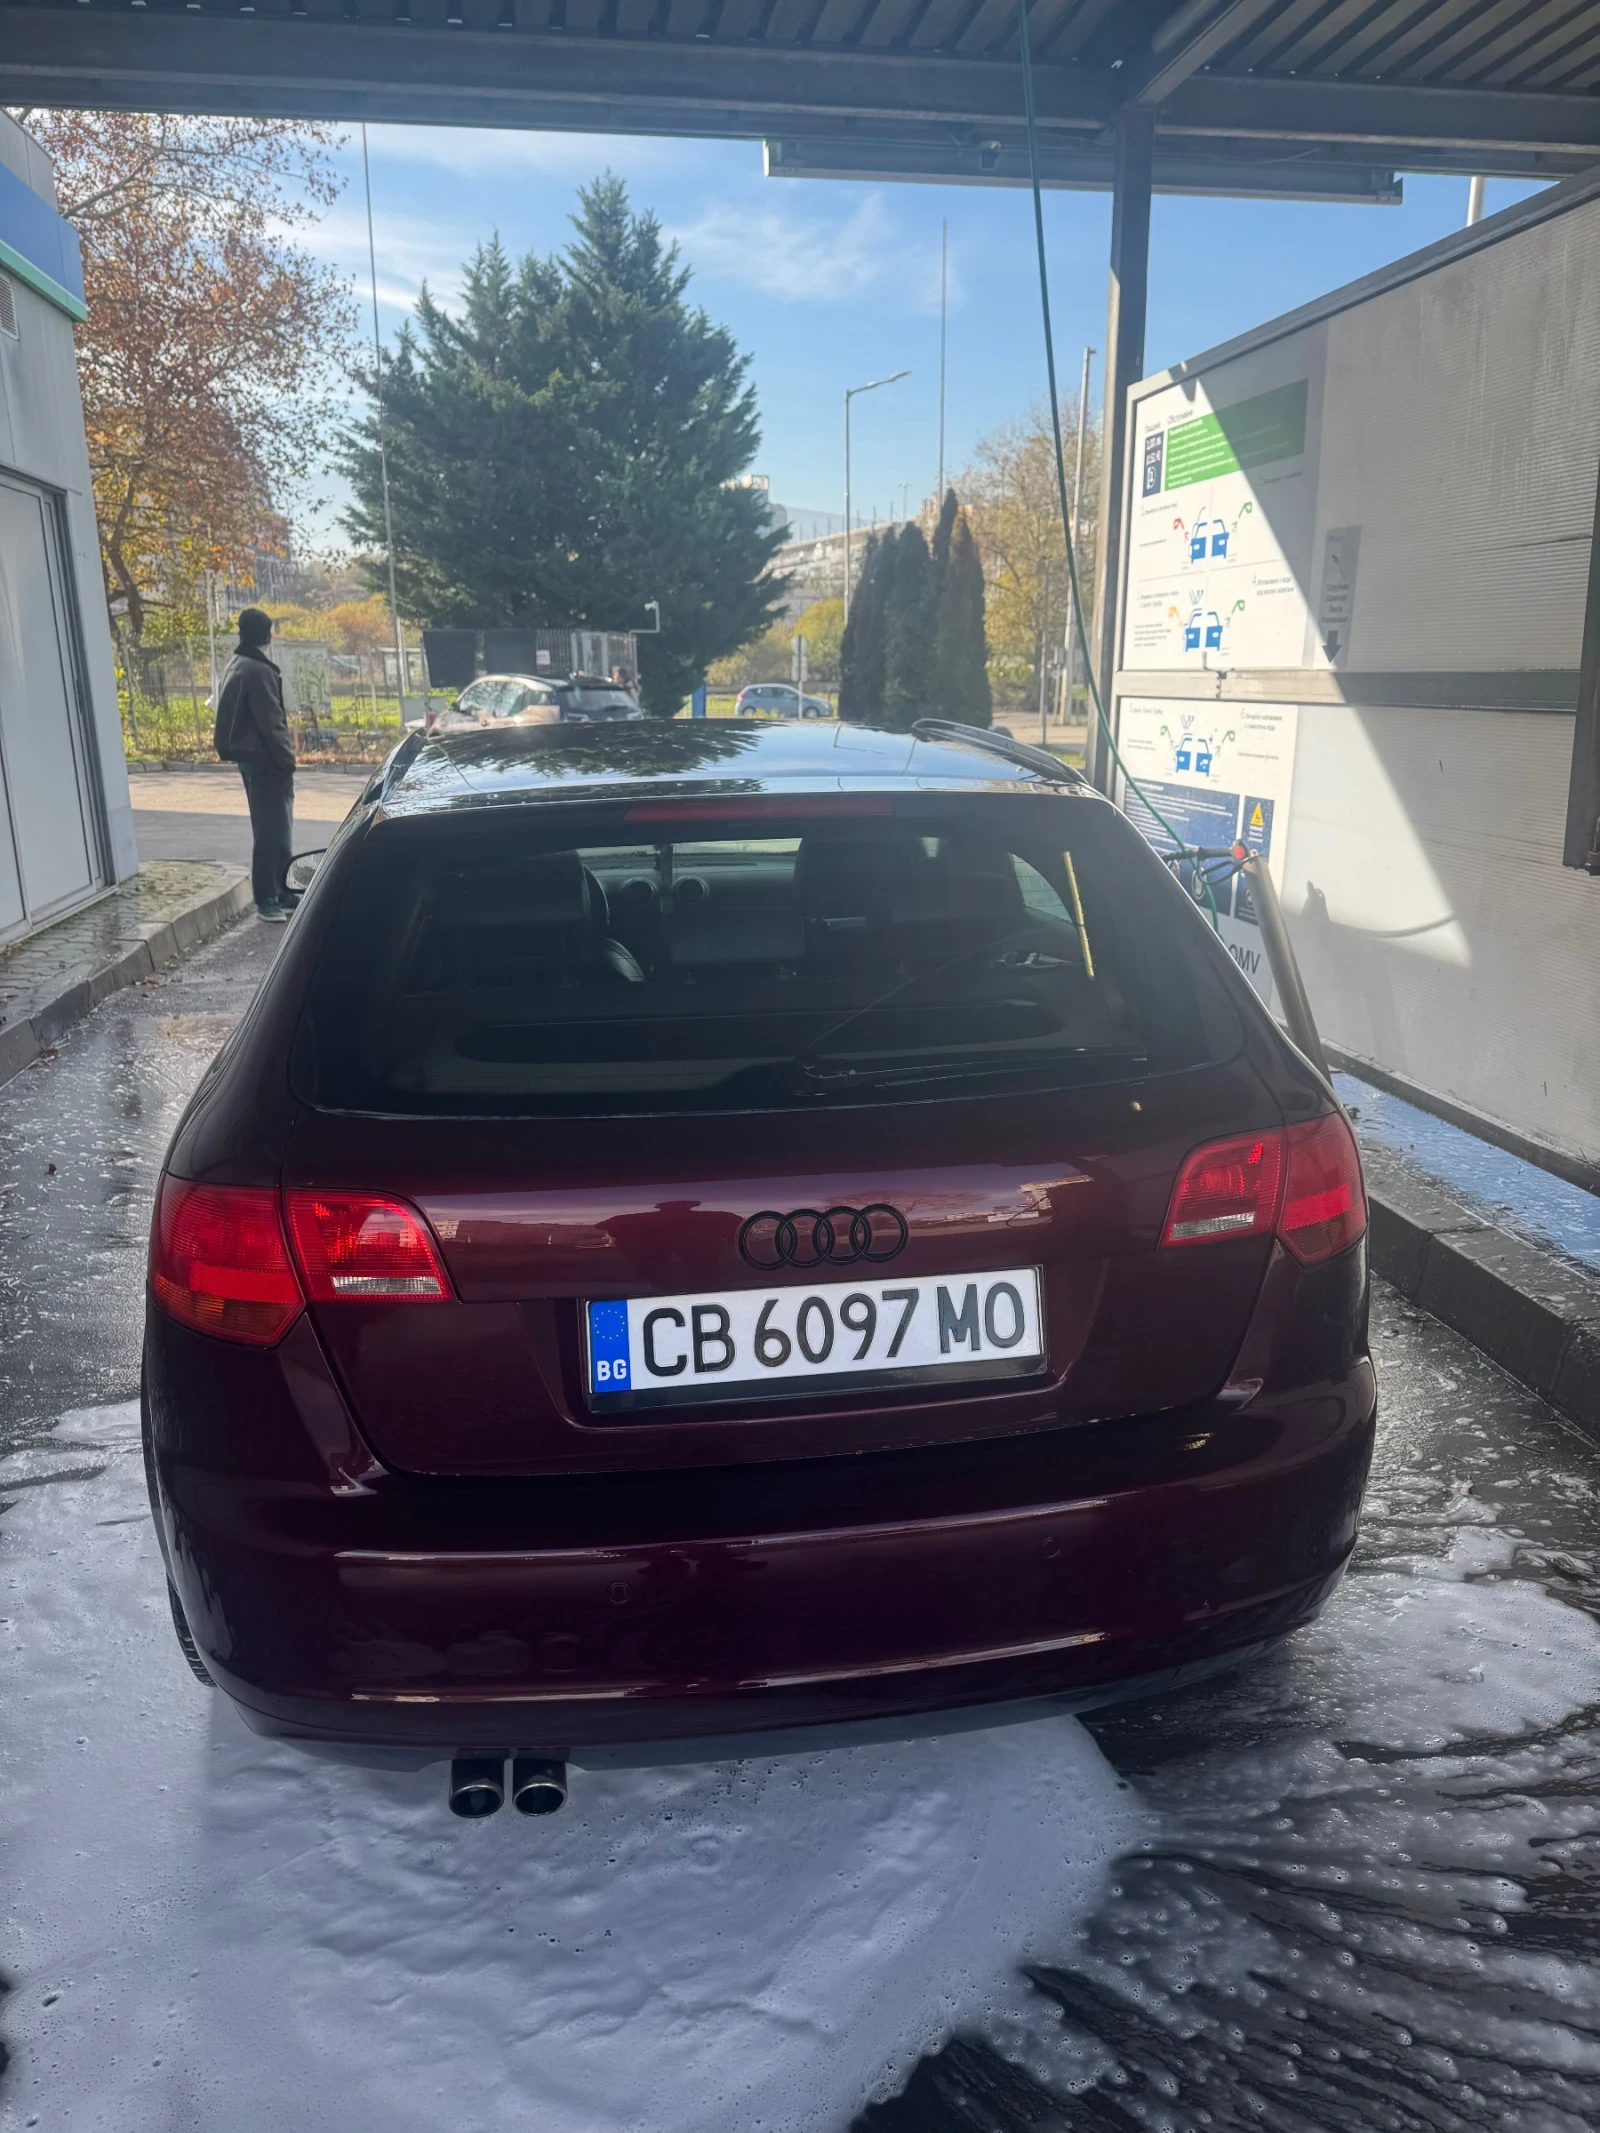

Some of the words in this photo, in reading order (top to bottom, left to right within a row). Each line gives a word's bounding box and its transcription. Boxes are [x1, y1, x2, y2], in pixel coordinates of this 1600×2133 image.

[1229, 943, 1261, 975] OMV
[643, 1303, 735, 1377] CB
[754, 1287, 920, 1367] 6097
[937, 1282, 1025, 1354] MO
[597, 1358, 627, 1381] BG
